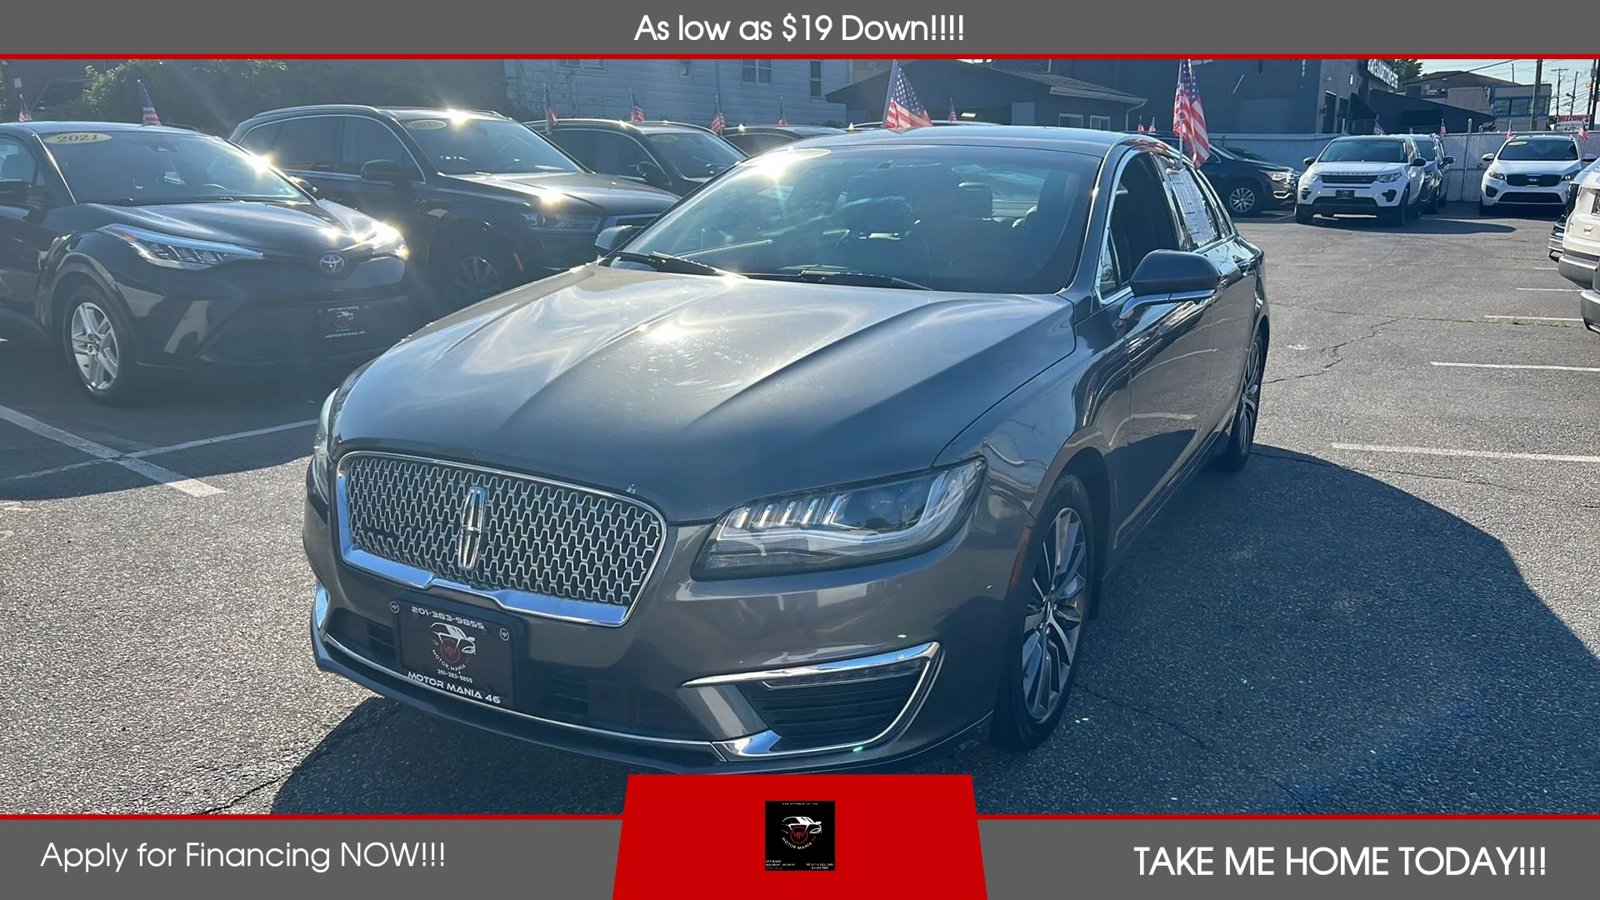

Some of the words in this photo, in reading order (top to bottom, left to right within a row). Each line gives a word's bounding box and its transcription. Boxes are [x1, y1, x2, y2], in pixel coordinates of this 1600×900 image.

[57, 134, 98, 143] 2021
[407, 671, 444, 689] MOTOR
[446, 682, 483, 699] MANIA
[485, 693, 501, 704] 46
